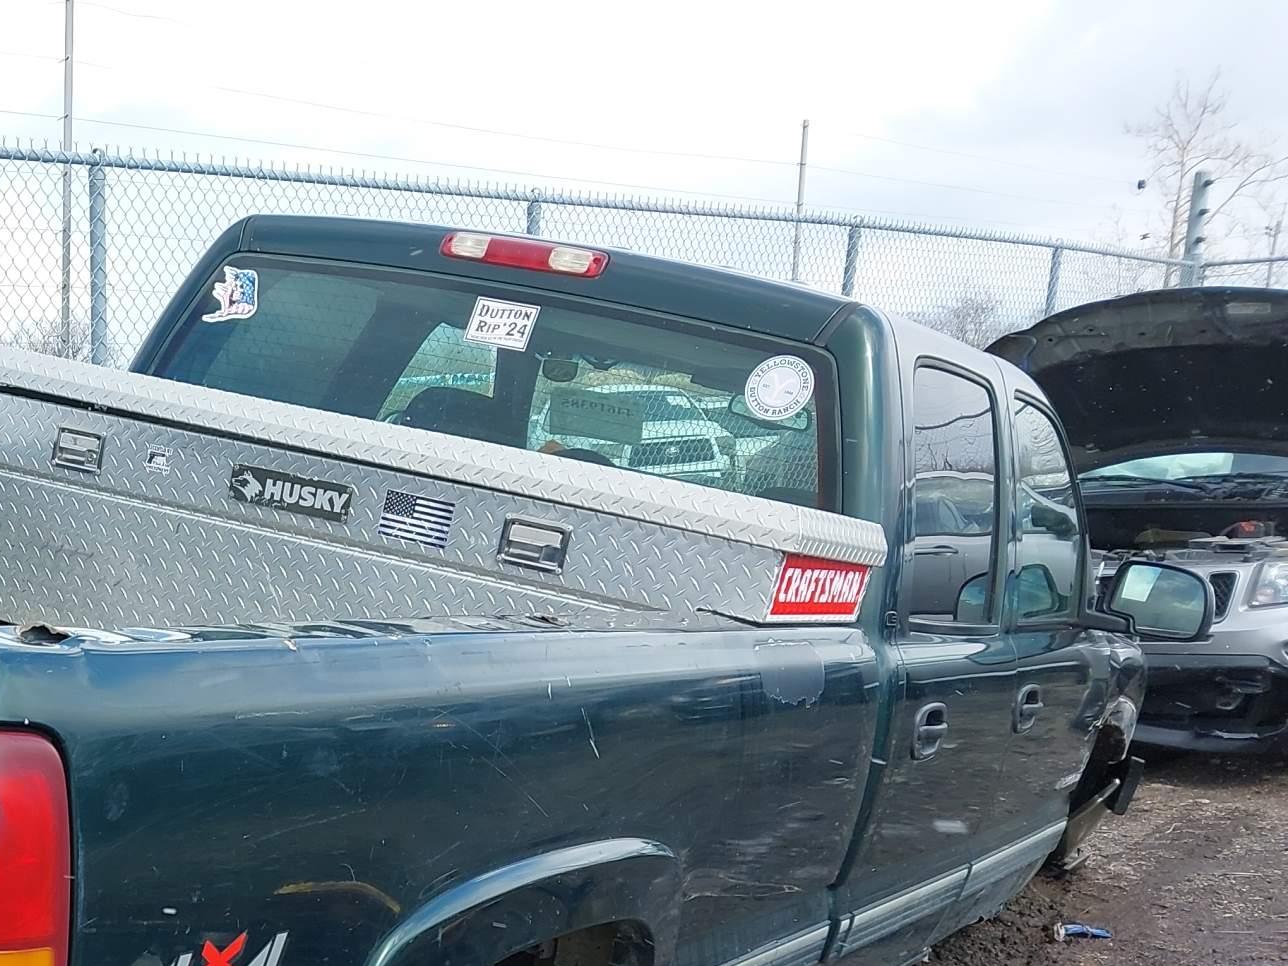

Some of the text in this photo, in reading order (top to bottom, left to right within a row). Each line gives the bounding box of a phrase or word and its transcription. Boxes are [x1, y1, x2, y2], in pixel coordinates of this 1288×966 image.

[478, 304, 533, 321] DUTTON
[754, 359, 809, 391] YELLOWSTONE
[749, 386, 801, 416] DUTTON RANCH
[264, 478, 350, 513] HUSKY
[778, 567, 863, 603] CRAFTSMAN
